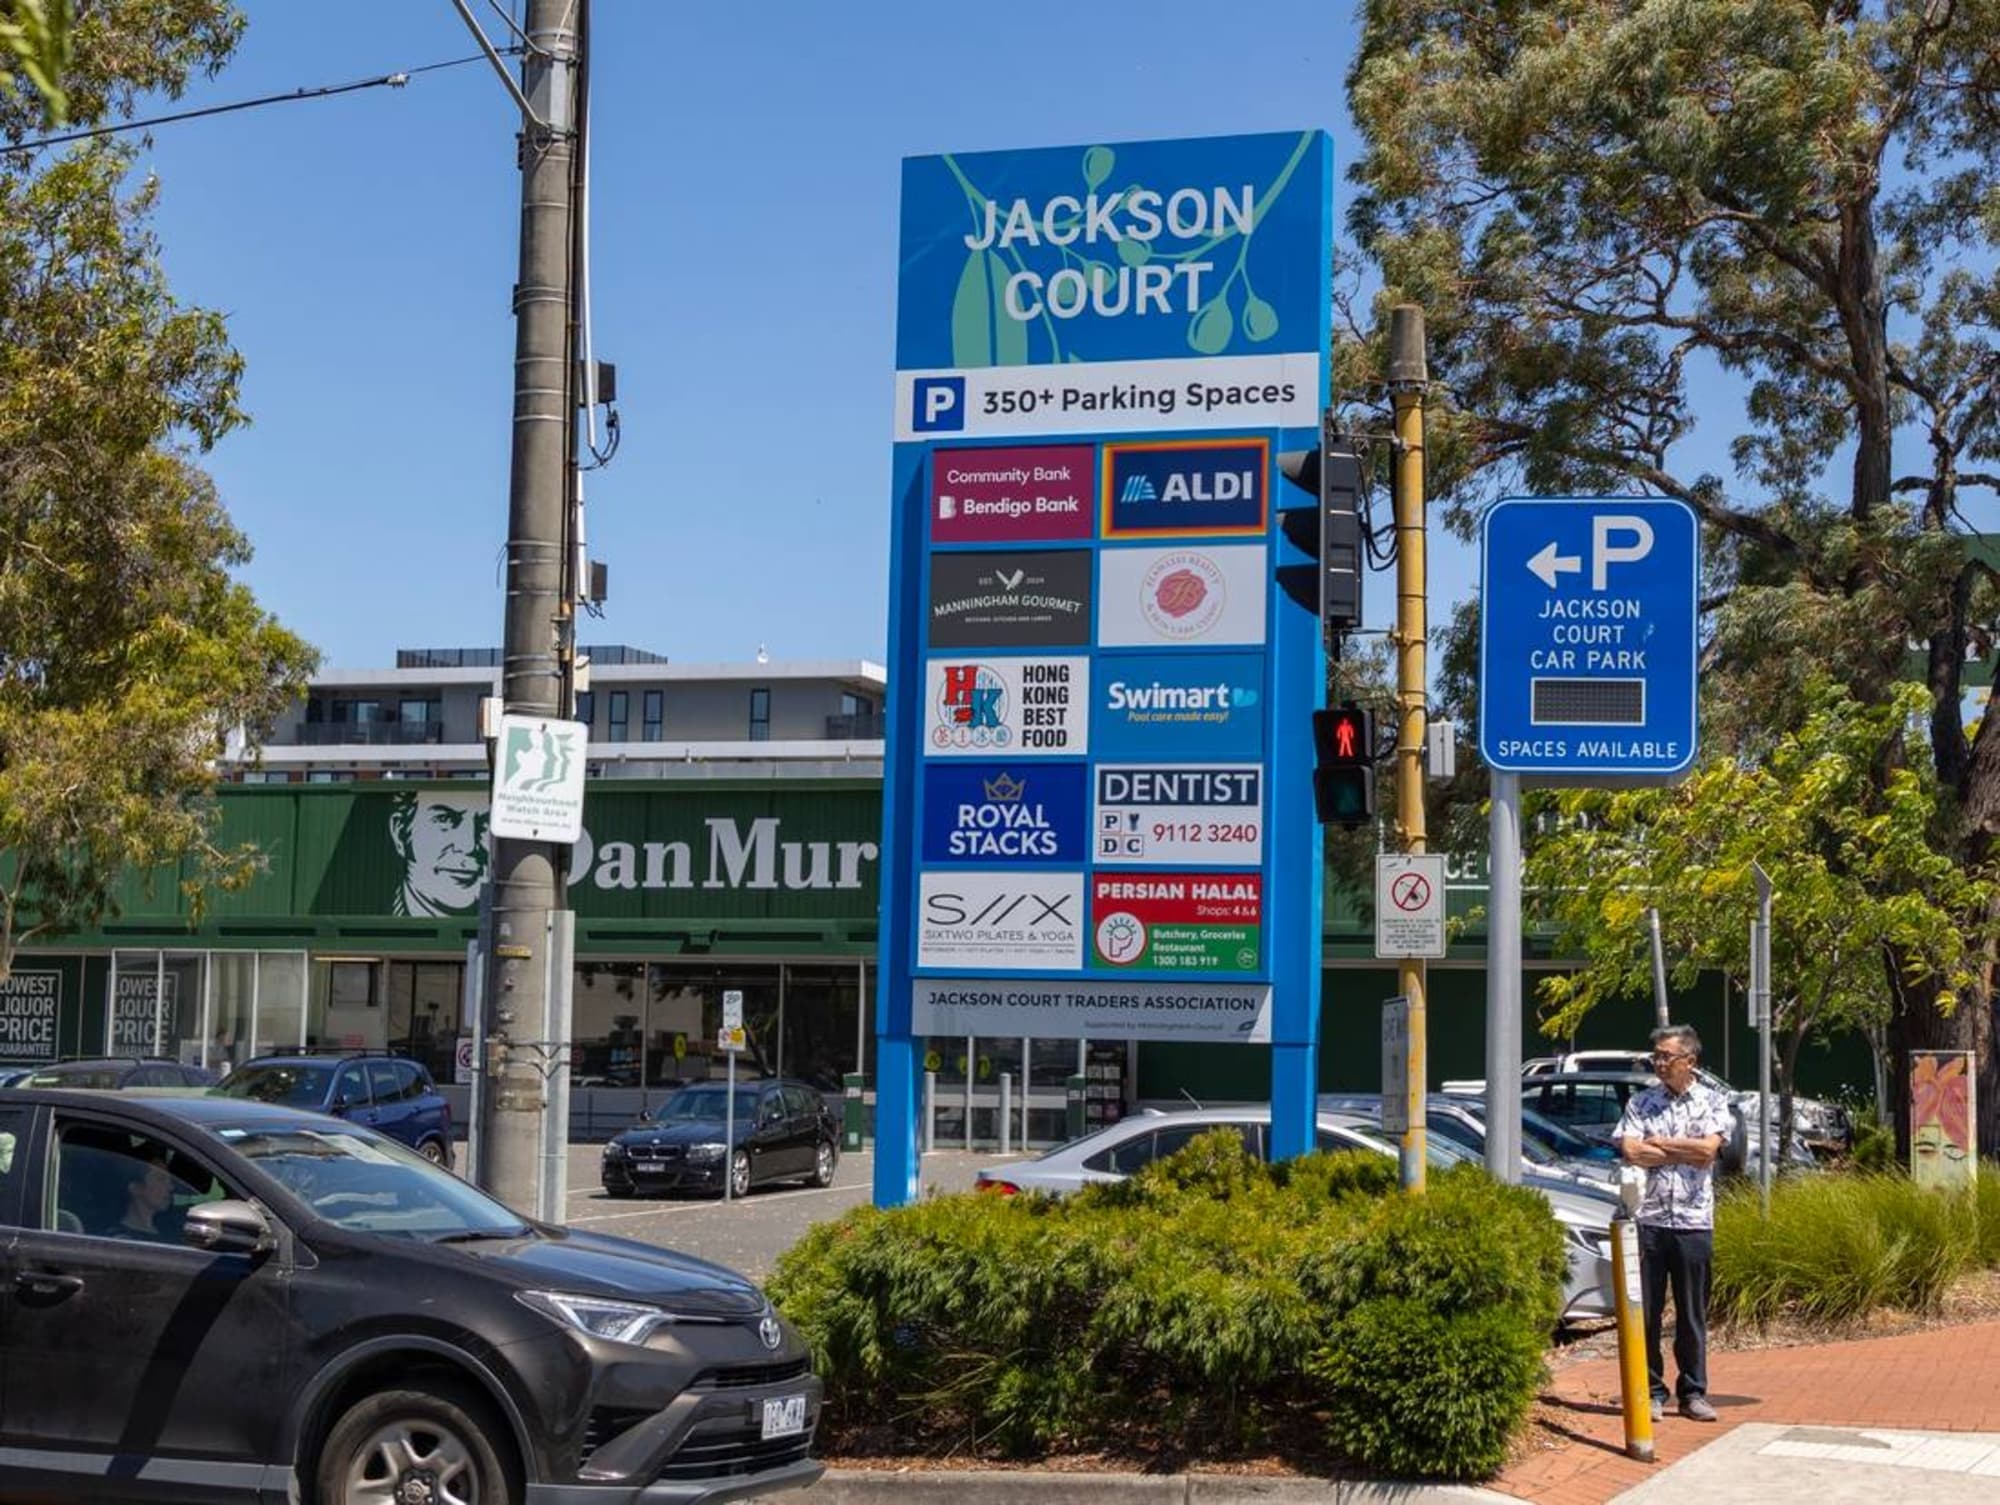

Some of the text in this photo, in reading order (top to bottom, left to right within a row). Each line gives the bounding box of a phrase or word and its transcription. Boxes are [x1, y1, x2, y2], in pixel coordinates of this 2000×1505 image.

[964, 185, 1254, 250] JACKSON
[1005, 262, 1213, 321] COURT
[926, 387, 955, 423] P
[983, 382, 1296, 414] 350+ Parking Spaces
[947, 466, 1071, 486] Community Bank
[1162, 471, 1253, 501] ALDI
[963, 495, 1079, 518] Bendigo Bank
[1592, 515, 1655, 590] P
[933, 595, 1083, 616] MANNINGHAM GOURMET
[1538, 600, 1640, 619] JACKSON
[1553, 625, 1625, 644] COURT
[1530, 650, 1647, 670] CAR PARK
[1023, 665, 1070, 683] HONG
[1023, 686, 1070, 704] KONG
[1108, 681, 1229, 709] Swimart
[1023, 708, 1067, 726] BEST
[1152, 713, 1172, 722] care
[1174, 711, 1201, 721] made
[1022, 729, 1067, 747] FOOD
[1499, 740, 1678, 759] SPACES AVAILABLE
[1105, 773, 1255, 802] DENTIST
[498, 792, 578, 808] Neighbourhood
[506, 804, 539, 816] Watch
[958, 804, 1049, 829] ROYAL
[1104, 815, 1118, 829] P
[1153, 823, 1257, 843] 9112 3240
[949, 830, 1057, 856] STACKS
[703, 818, 879, 889] Mur
[1097, 882, 1258, 900] PERSIAN HALAL
[1196, 904, 1231, 916] Shops:
[925, 929, 974, 940] SIXTWO
[977, 930, 1024, 941] PILATES
[1041, 930, 1075, 941] YOGA
[1153, 929, 1246, 940] Butchery, Groceries
[1153, 942, 1205, 952] Restaurant
[929, 992, 1256, 1011] JACKSON COURT TRADERS ASSOCIATION
